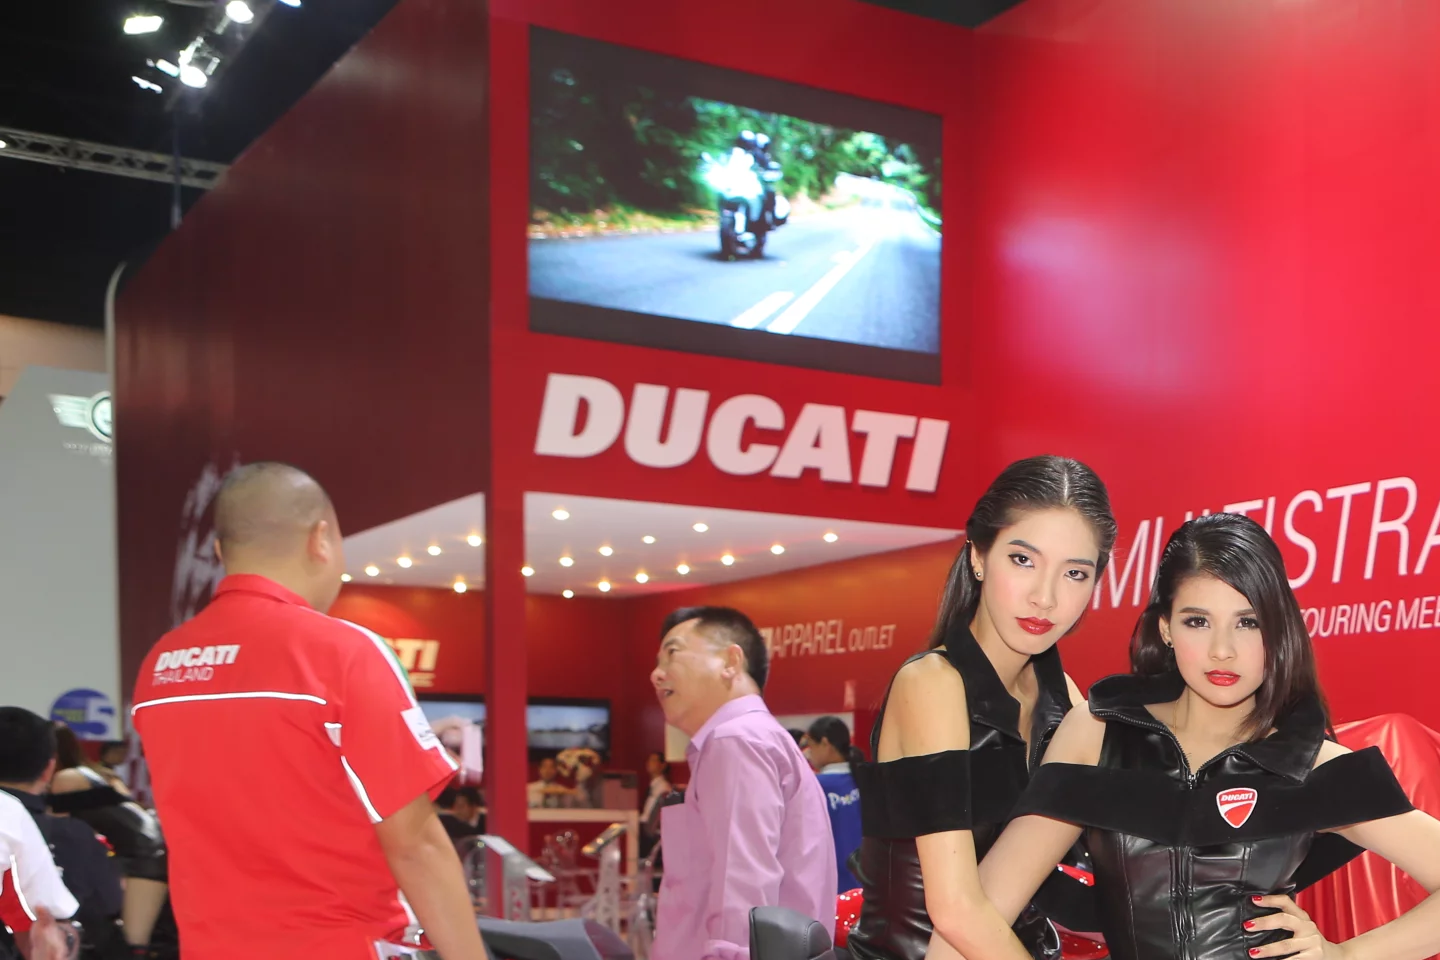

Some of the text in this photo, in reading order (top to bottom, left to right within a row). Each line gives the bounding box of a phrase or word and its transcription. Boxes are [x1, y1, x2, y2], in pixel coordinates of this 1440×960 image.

[534, 373, 950, 493] DUCATI
[1299, 599, 1393, 638] OURING
[771, 619, 847, 658] APPAREL
[848, 623, 897, 653] OUTLET
[153, 644, 241, 673] DUCATI
[151, 666, 215, 687] THAILAND
[1221, 792, 1254, 802] DUCATI
